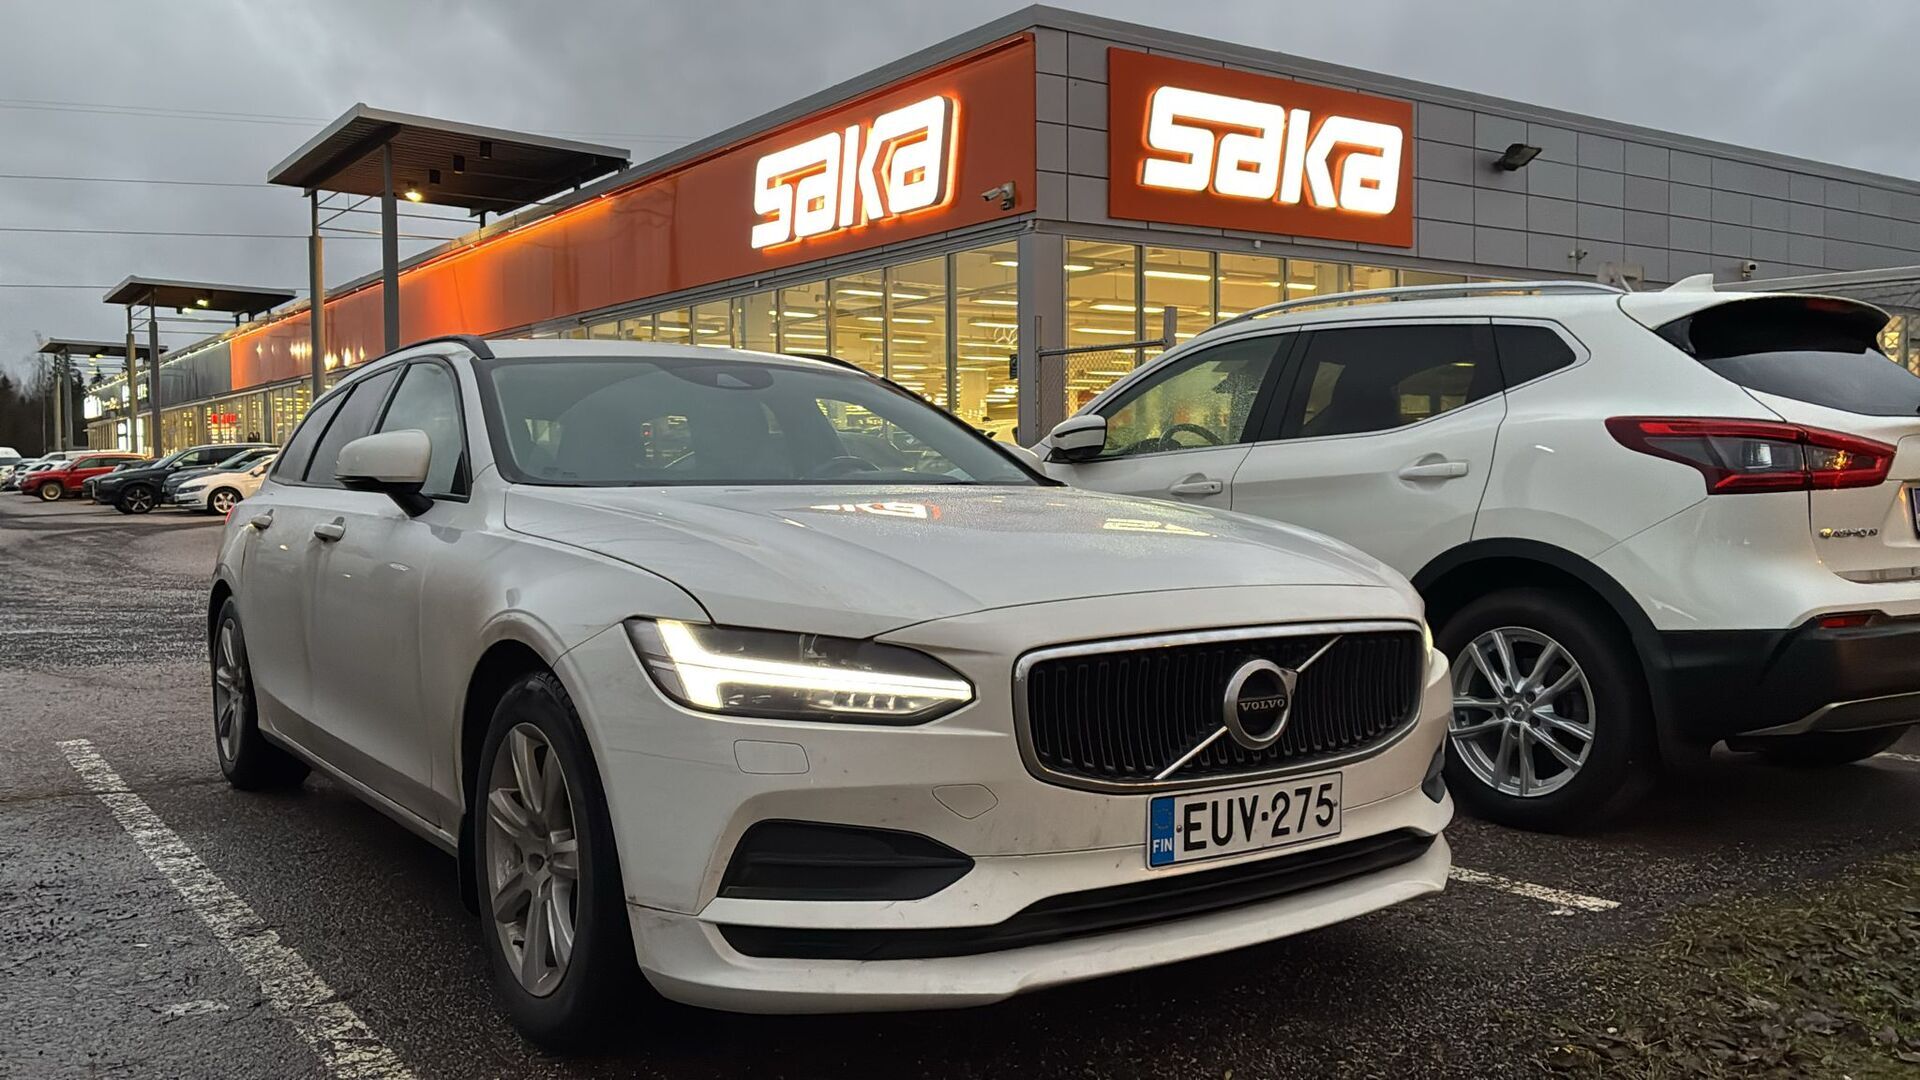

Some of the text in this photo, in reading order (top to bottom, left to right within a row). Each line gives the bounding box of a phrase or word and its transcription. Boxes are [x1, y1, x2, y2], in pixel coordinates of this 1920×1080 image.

[1240, 699, 1285, 711] VOLVO
[1183, 782, 1334, 852] EUV-275
[1152, 837, 1173, 853] FIN
